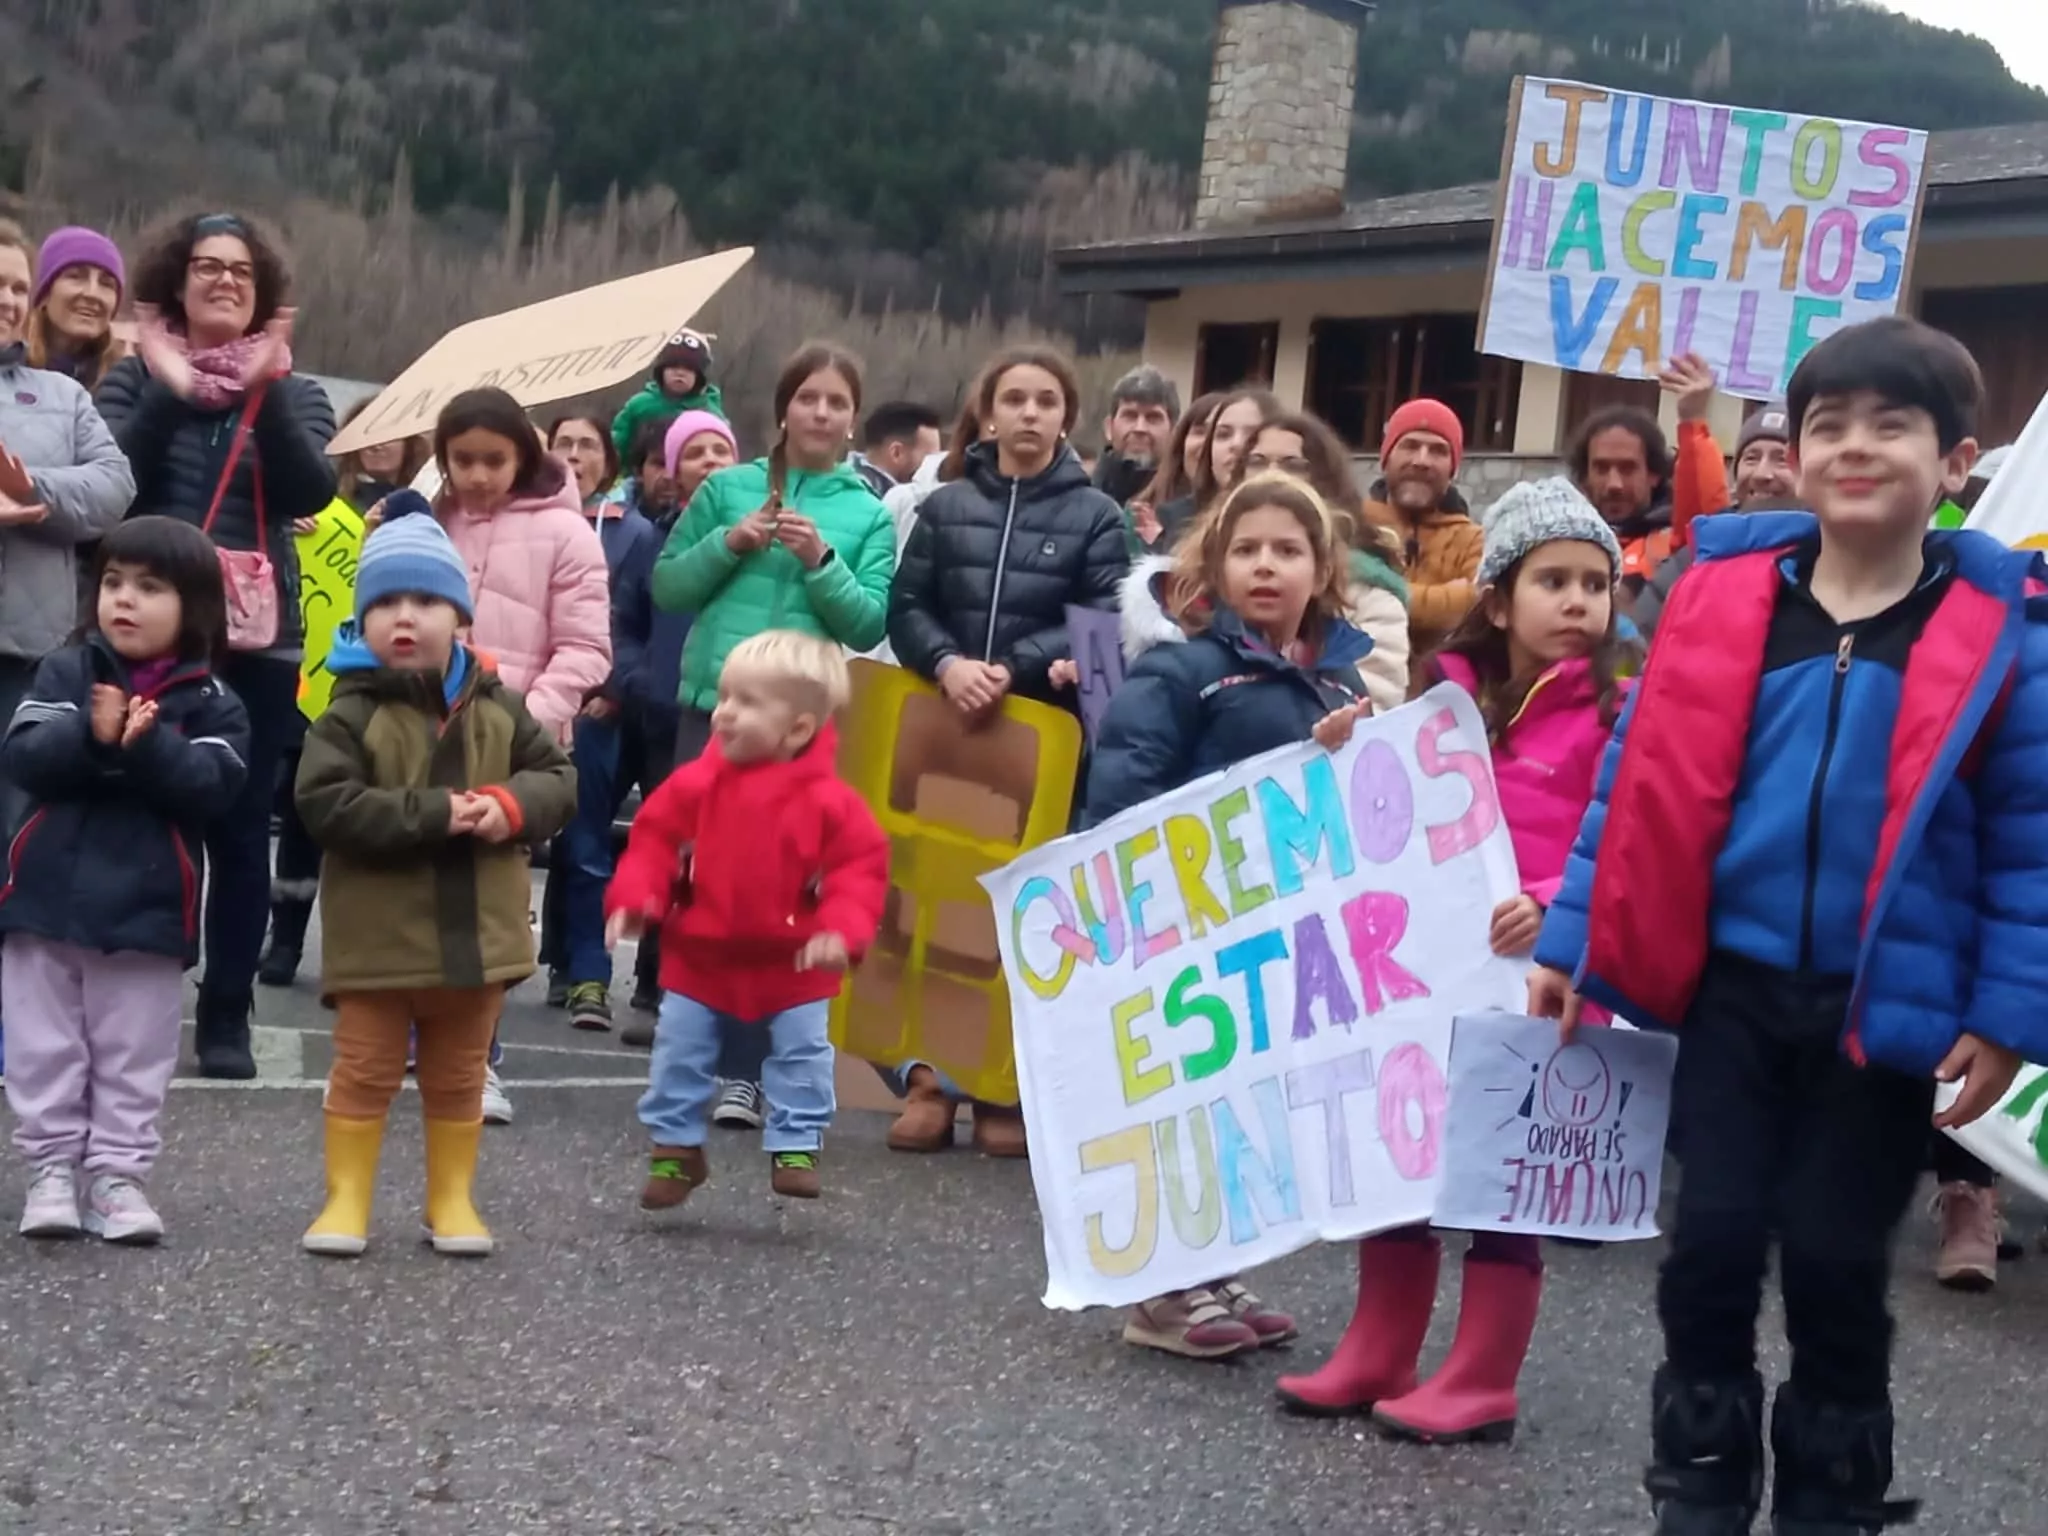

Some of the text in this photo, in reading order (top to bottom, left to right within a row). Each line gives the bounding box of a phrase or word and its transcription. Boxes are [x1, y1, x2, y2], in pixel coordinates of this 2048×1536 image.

[1533, 85, 1910, 207] JUNTOS
[1503, 176, 1906, 300] HACEMOS
[1012, 707, 1500, 999] QUEREMOS
[1111, 891, 1431, 1107] ESTAR
[1079, 1041, 1447, 1278] JUNTO
[1528, 1123, 1628, 1163] SEPARADO
